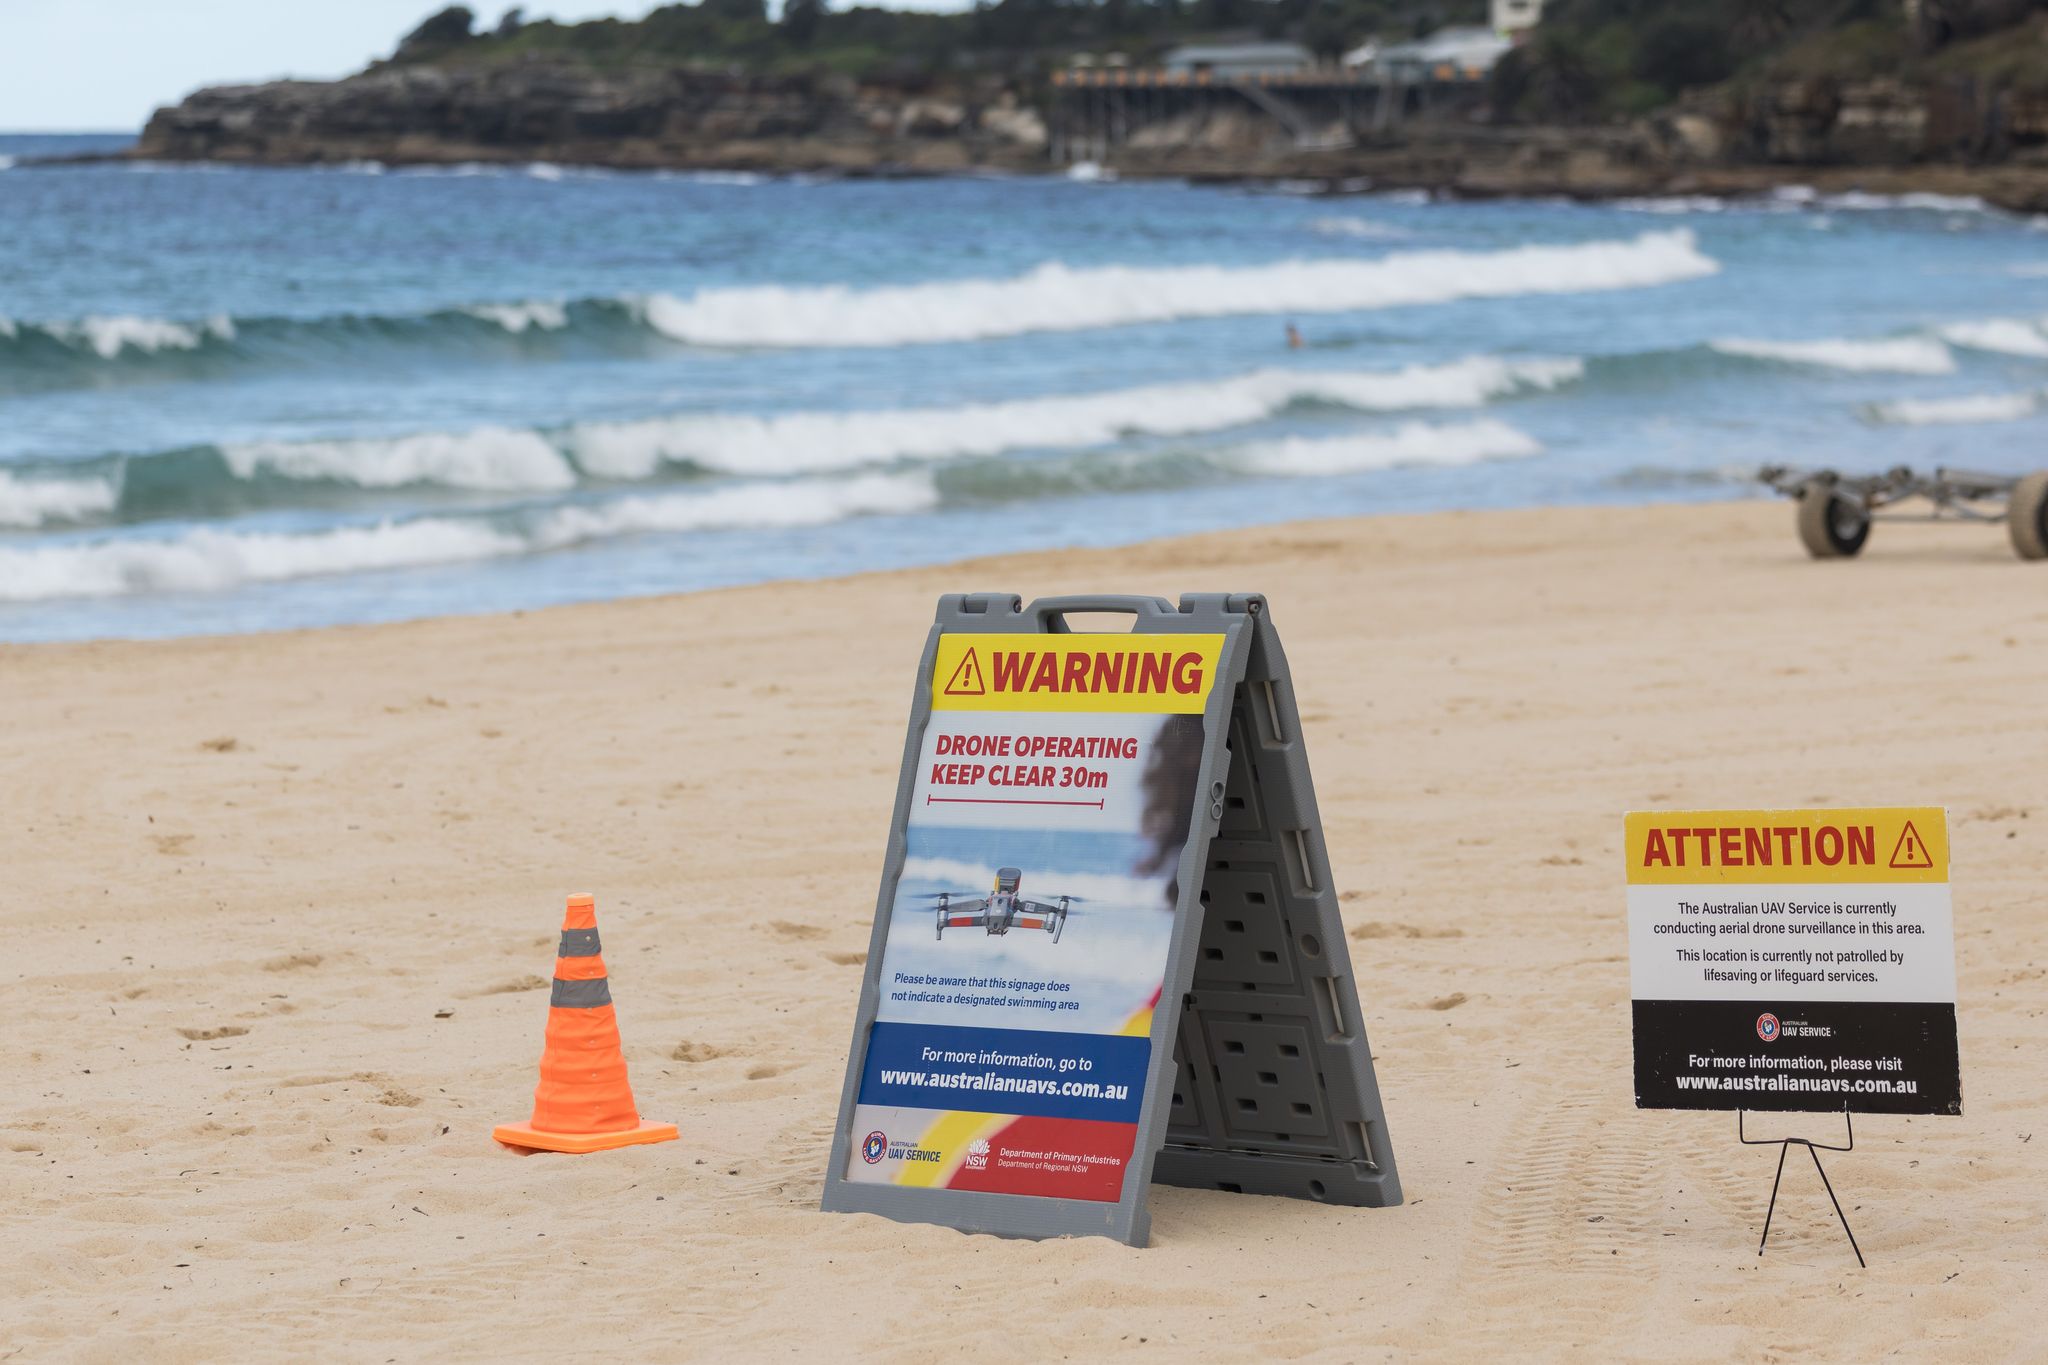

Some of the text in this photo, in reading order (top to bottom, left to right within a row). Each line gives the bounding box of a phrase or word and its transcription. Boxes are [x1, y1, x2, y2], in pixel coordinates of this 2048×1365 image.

[993, 652, 1204, 695] WARNING
[936, 735, 1138, 759] DRONE OPERATING
[931, 764, 1109, 788] KEEP CLEAR 30m
[1643, 825, 1876, 867] ATTENTION
[1678, 902, 1897, 917] The Australian UAV Service is currently
[1654, 922, 1925, 936] conducting aerial drone surveillance in this area.
[1676, 950, 1904, 965] This location is currently not patrolled by
[895, 973, 1070, 993] Please be aware that this signage does
[1704, 969, 1878, 985] lifesaving or lifeguard services.
[891, 991, 1080, 1012] not indicate a designated swimming area
[1782, 1027, 1831, 1037] UAV SERVICE
[922, 1047, 1093, 1072] For more information, go to
[1689, 1054, 1903, 1073] For more information, please visit
[881, 1070, 1129, 1100] www.australianuavs.com.au
[1676, 1074, 1917, 1094] www.australianuavs.com.au
[888, 1148, 941, 1163] UAV SERVICE
[966, 1155, 989, 1167] NSW
[1000, 1148, 1120, 1166] Department of Primary Industries
[998, 1159, 1034, 1168] Department
[1043, 1162, 1070, 1172] Regional
